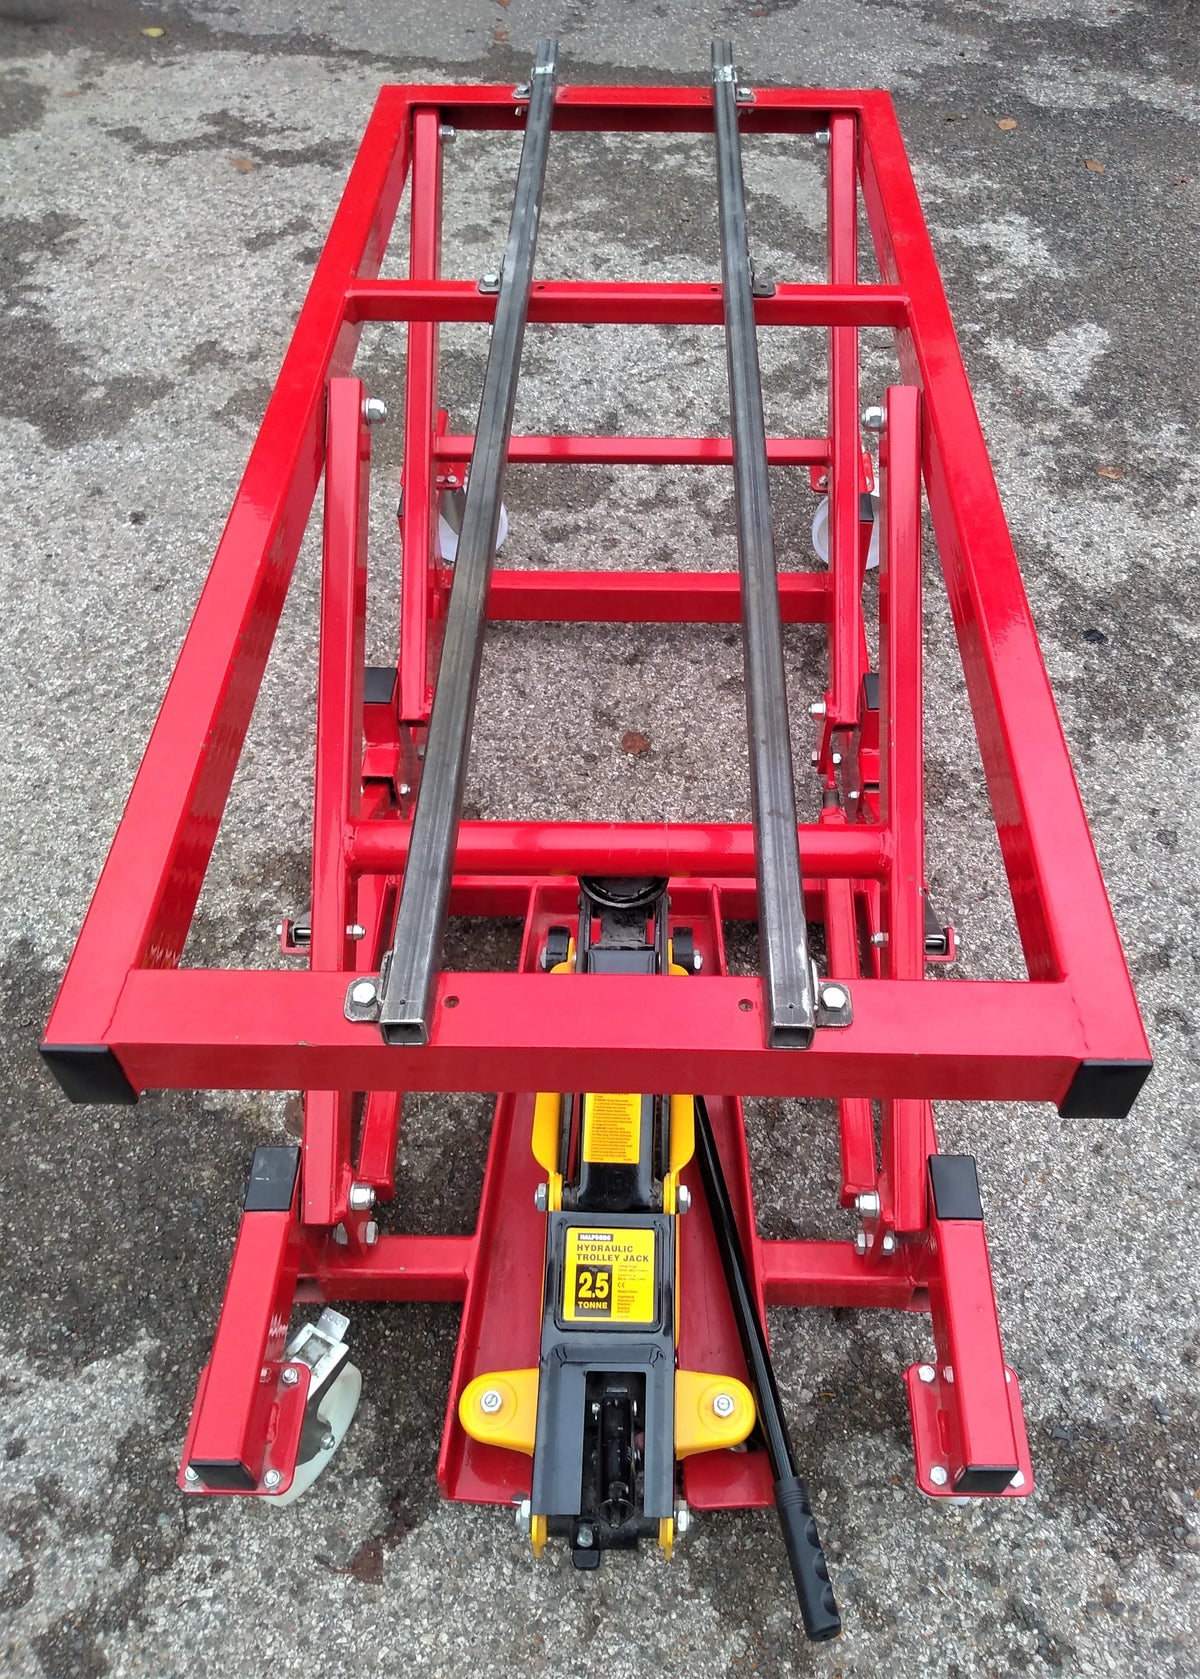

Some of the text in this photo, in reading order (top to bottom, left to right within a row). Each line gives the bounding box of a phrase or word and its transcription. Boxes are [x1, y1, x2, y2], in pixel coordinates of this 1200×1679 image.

[577, 1244, 633, 1252] HYDRAULIC
[577, 1253, 620, 1261] TROLLEY
[578, 1272, 609, 1298] 2.5
[578, 1301, 608, 1309] TONNE
